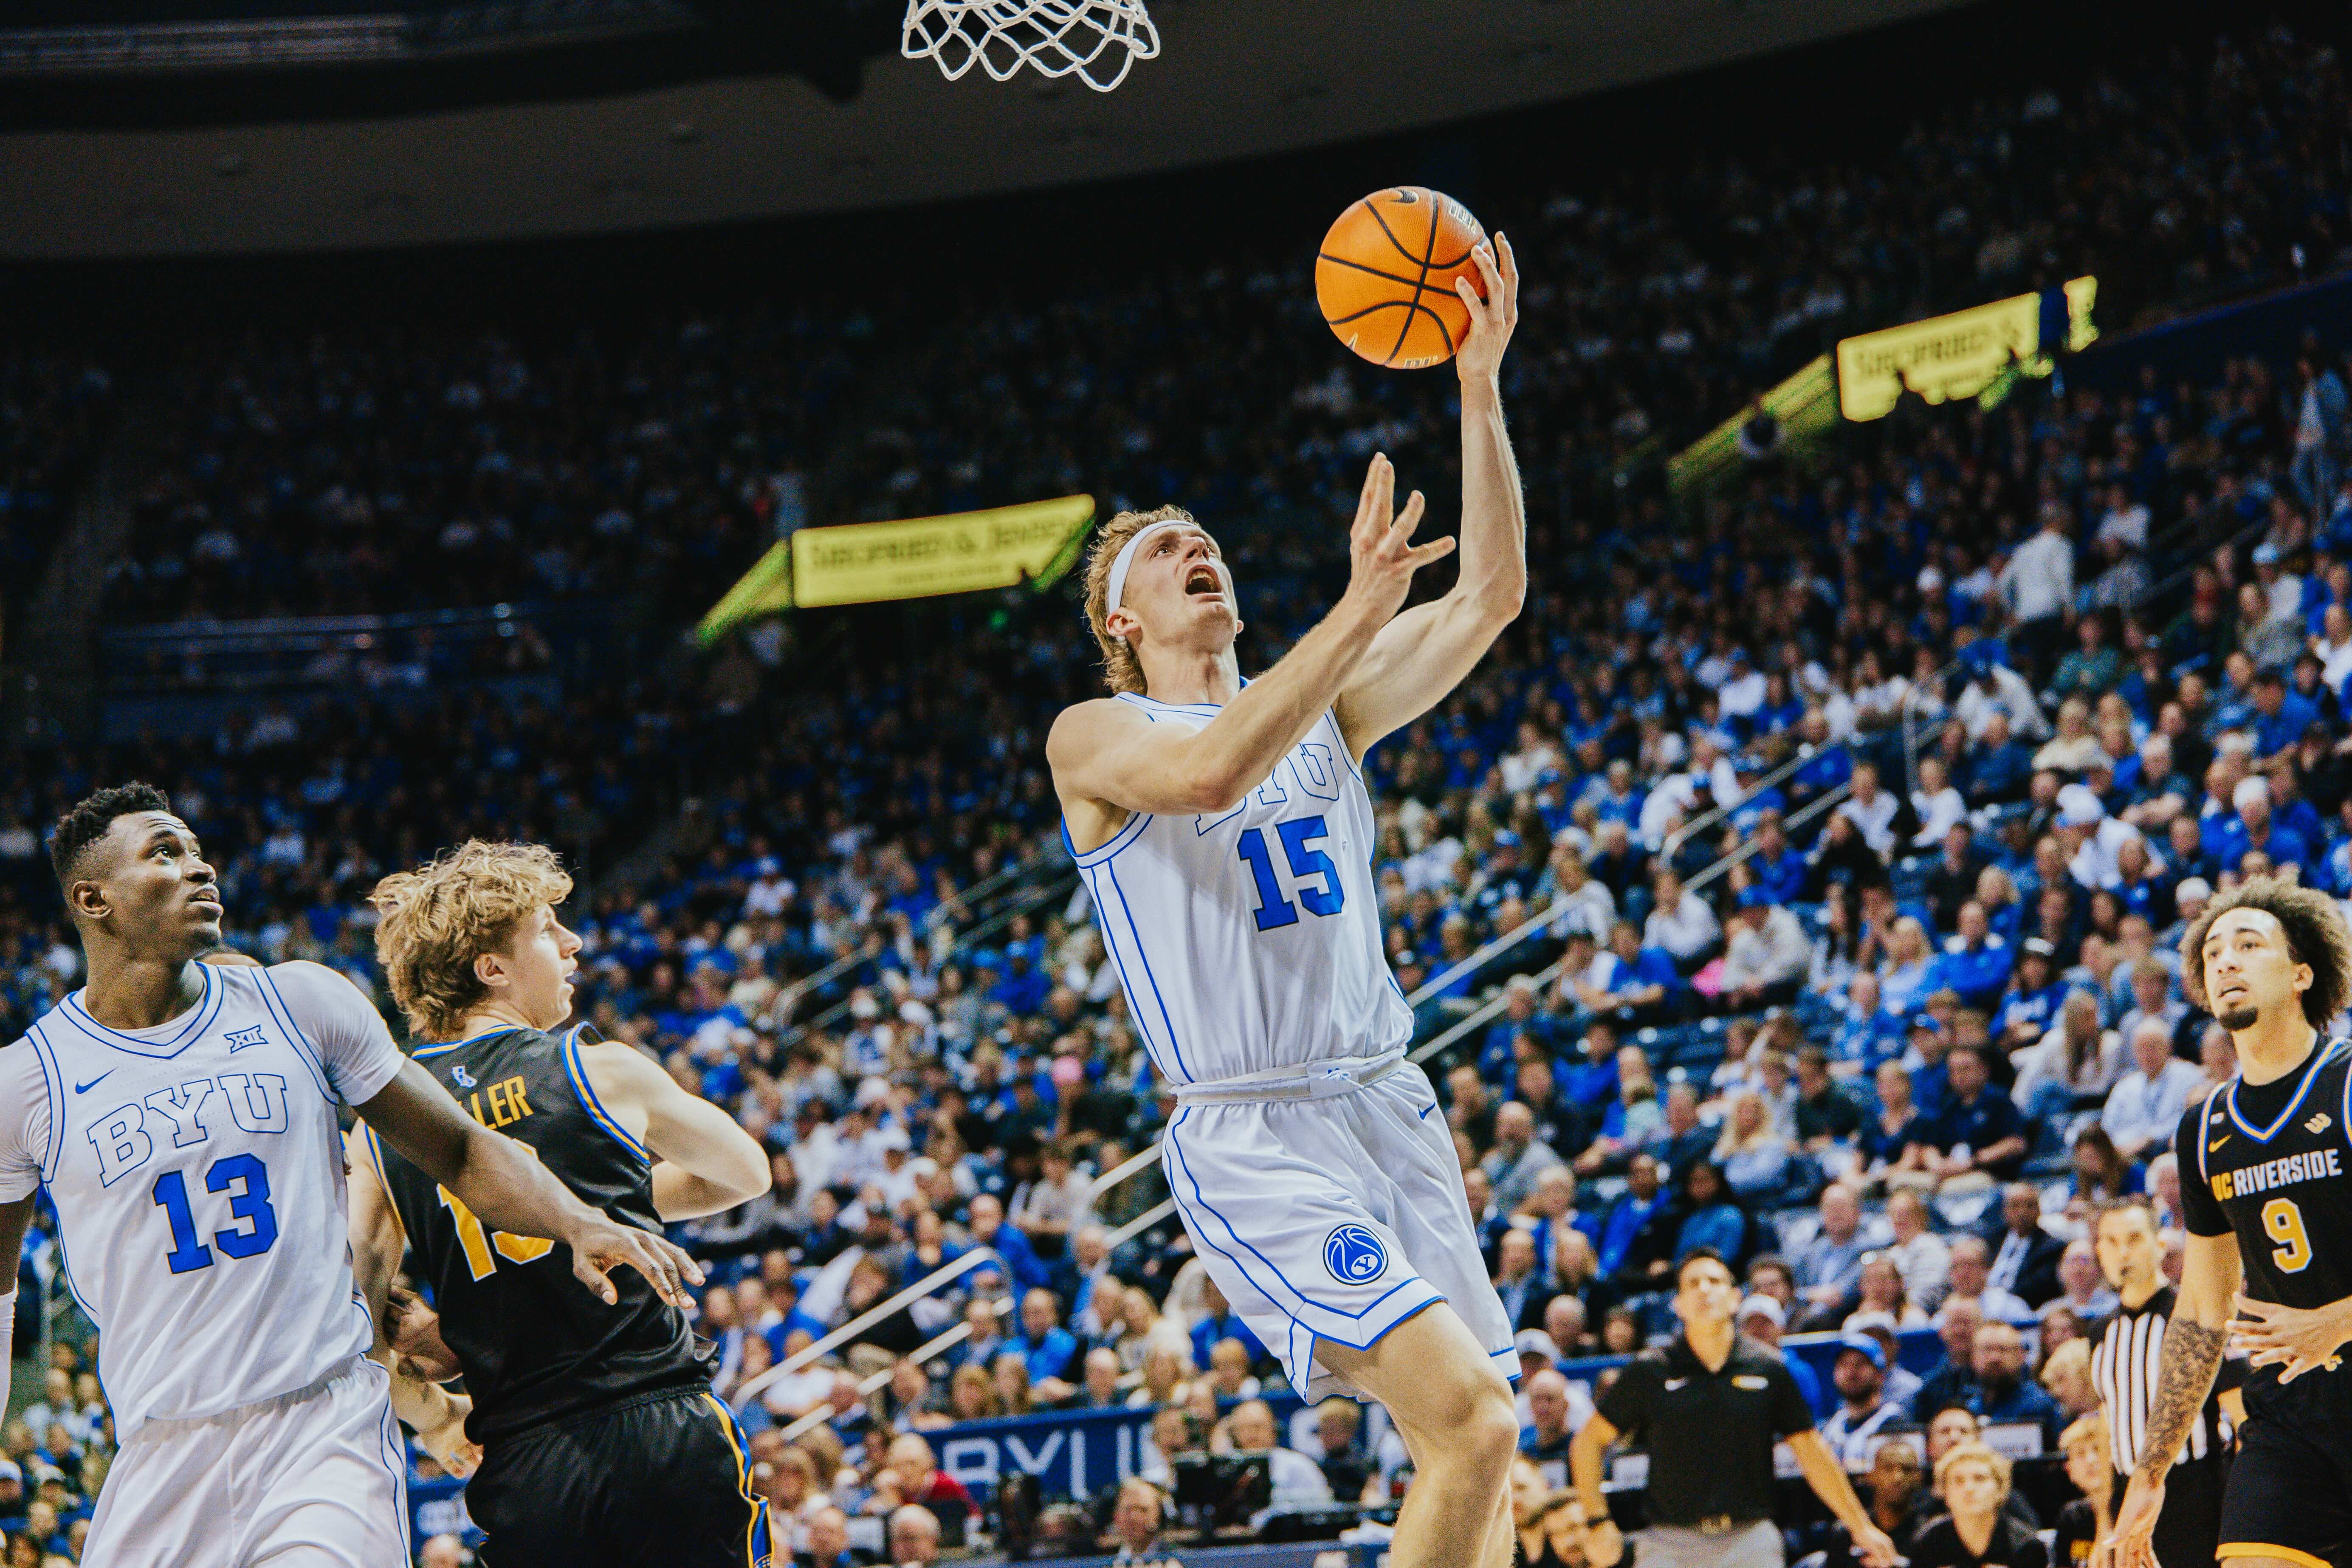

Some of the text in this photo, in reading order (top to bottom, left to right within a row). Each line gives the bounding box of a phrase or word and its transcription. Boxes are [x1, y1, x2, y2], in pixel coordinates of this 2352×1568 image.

[1237, 815, 1344, 931] 15
[86, 1074, 288, 1188] BYU
[2233, 1148, 2343, 1197] RIVERSIDE
[152, 1153, 278, 1274] 13
[2262, 1198, 2313, 1274] 9
